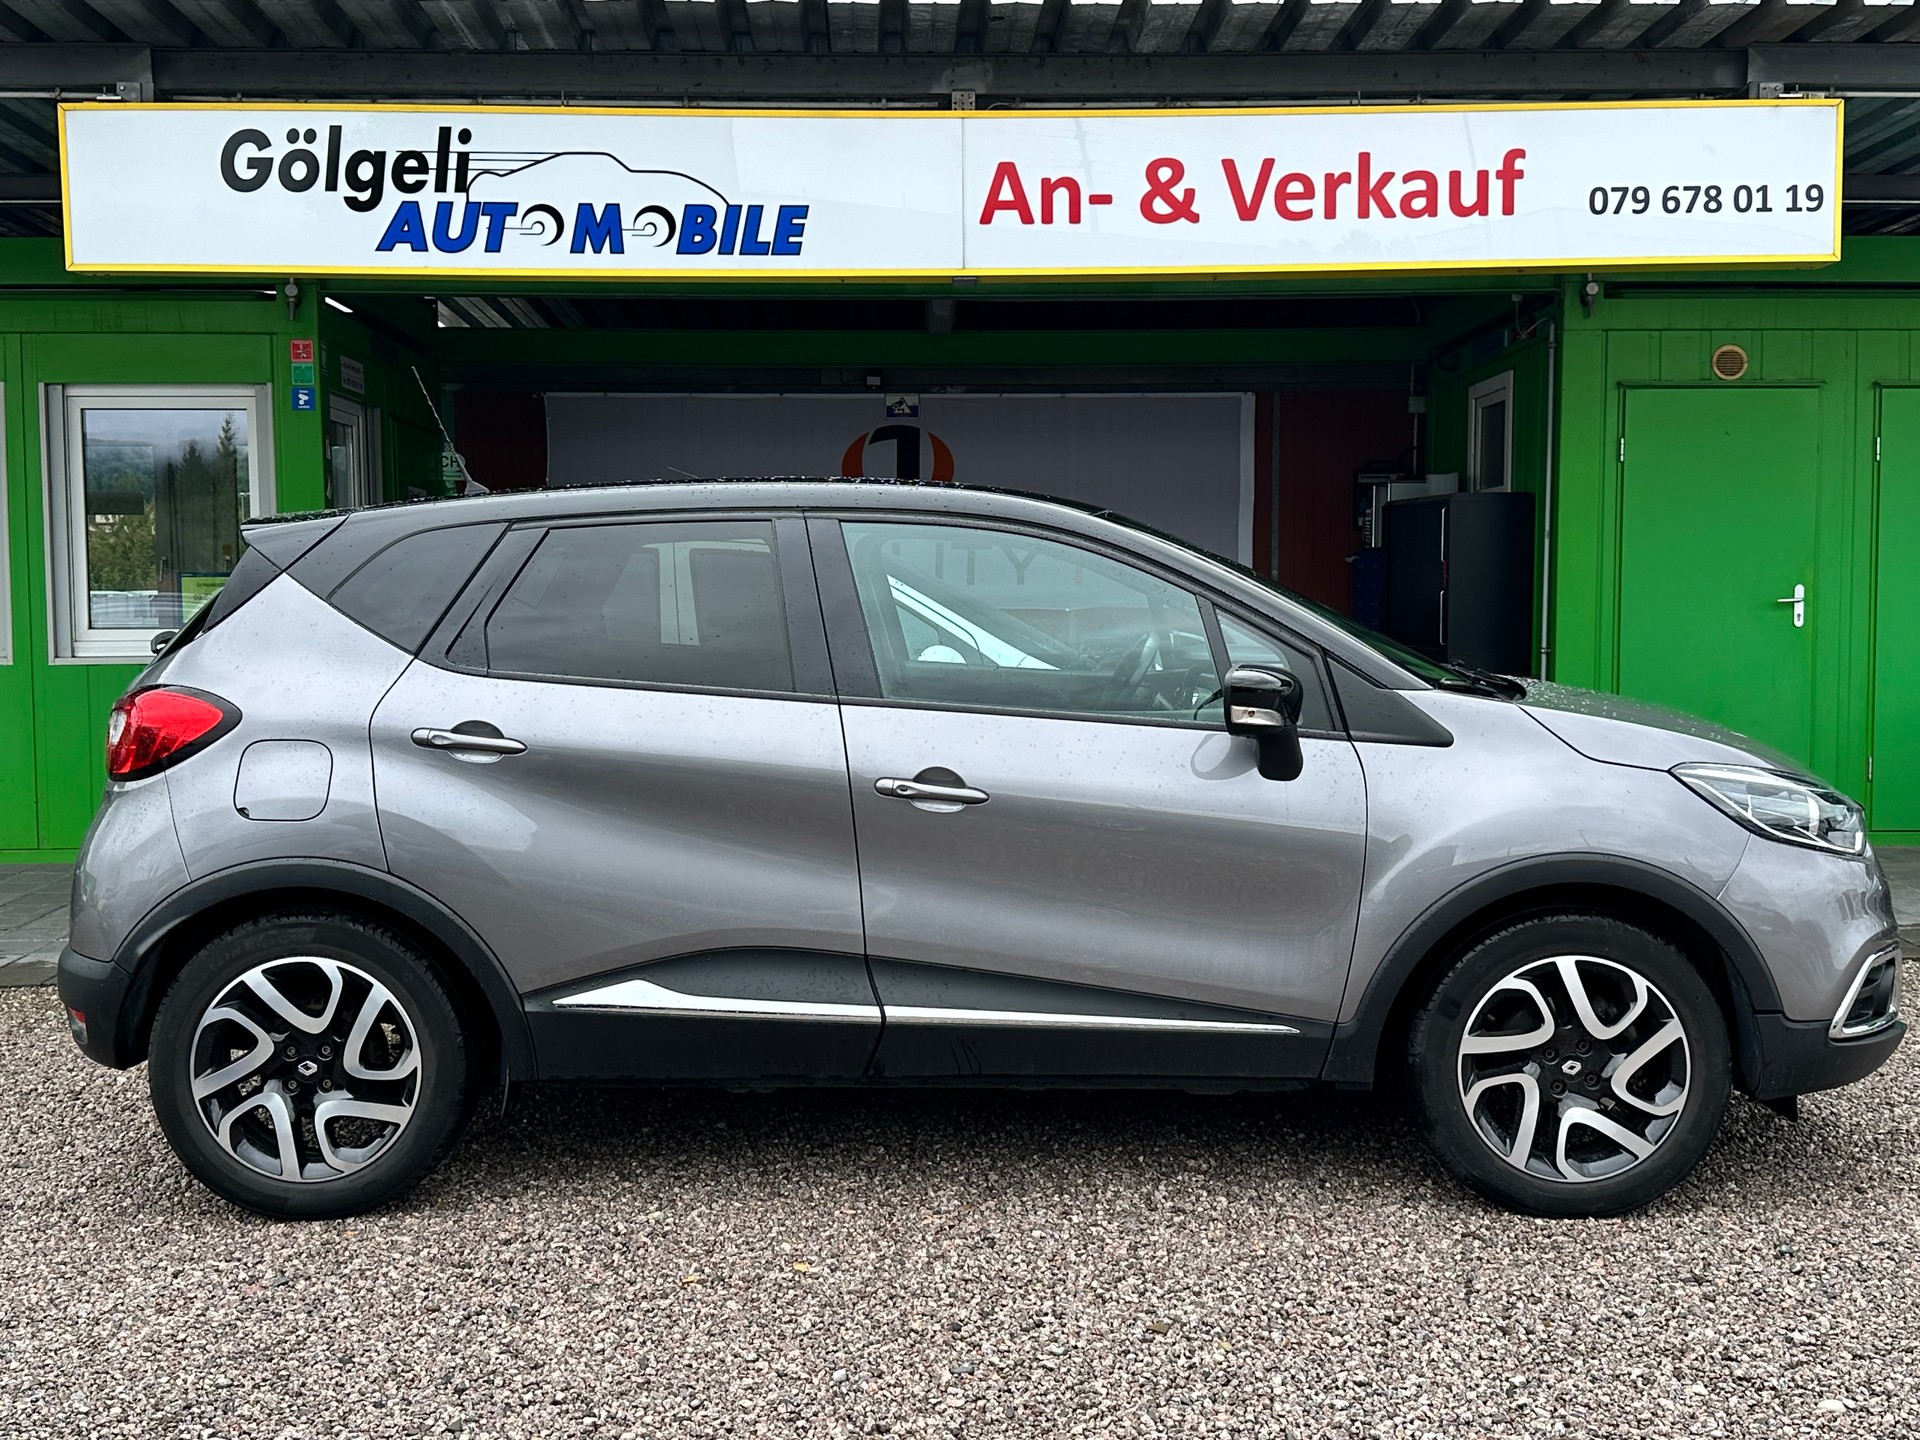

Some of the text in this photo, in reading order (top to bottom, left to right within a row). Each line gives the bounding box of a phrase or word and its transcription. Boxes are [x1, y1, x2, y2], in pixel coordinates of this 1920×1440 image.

[220, 125, 472, 213] Gölgeli
[979, 148, 1526, 225] An- & Verkauf
[1588, 183, 1825, 216] 079 678 01 19
[374, 200, 810, 256] AUTOMOBILE
